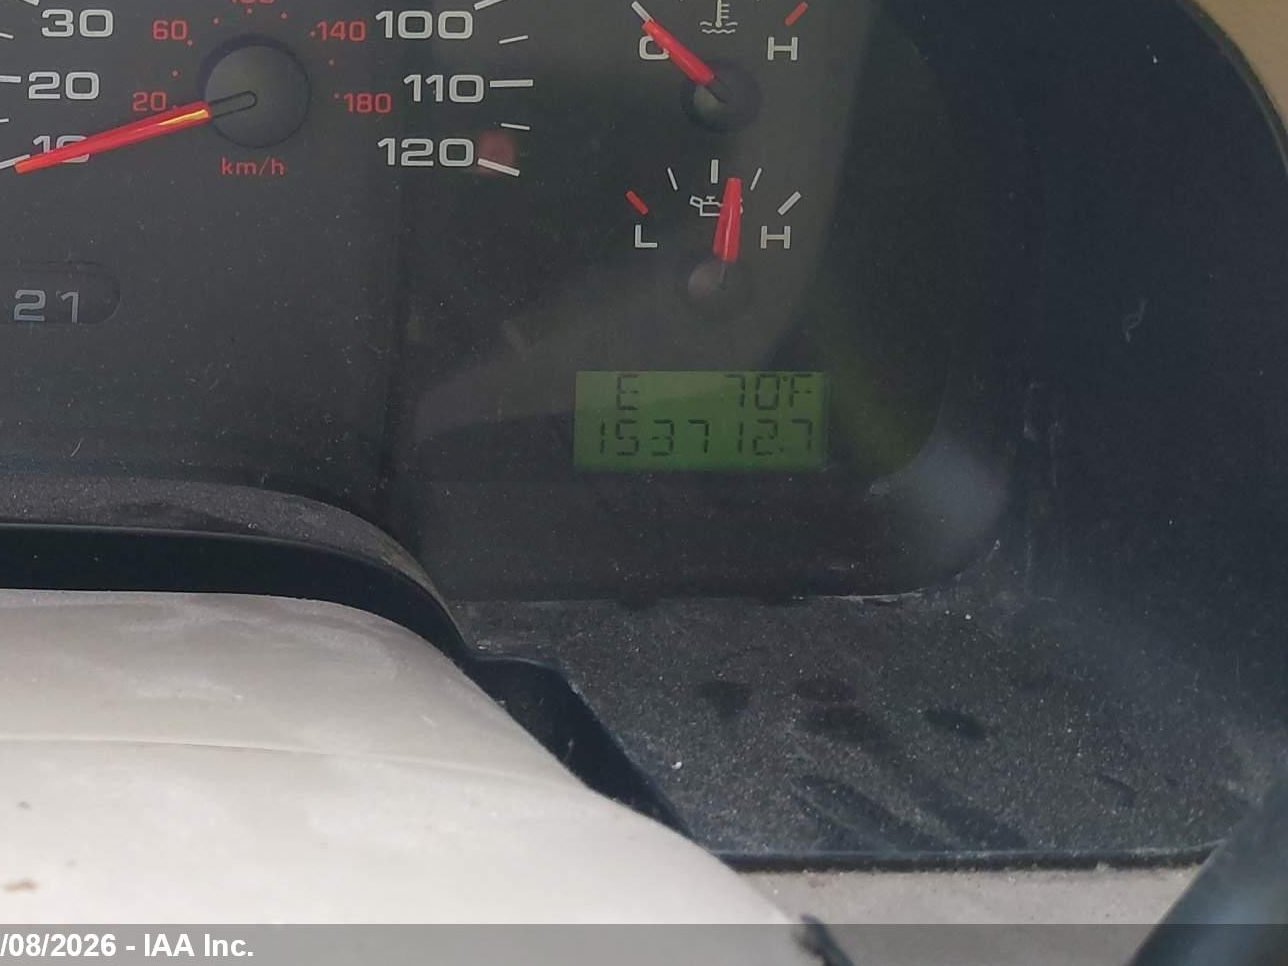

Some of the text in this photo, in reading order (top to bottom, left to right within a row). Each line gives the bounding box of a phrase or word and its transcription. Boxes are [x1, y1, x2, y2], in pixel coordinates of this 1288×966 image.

[40, 9, 114, 38] 30
[151, 20, 189, 41] 60
[316, 21, 366, 42] 140
[375, 10, 474, 40] 100
[638, 34, 669, 61] C
[767, 36, 798, 61] H
[27, 71, 100, 100] 20
[403, 73, 485, 103] 110
[131, 91, 167, 112] 20
[343, 93, 392, 114] 180
[377, 137, 475, 167] 120
[220, 156, 286, 177] km/h
[634, 224, 658, 248] L
[760, 225, 791, 250] H
